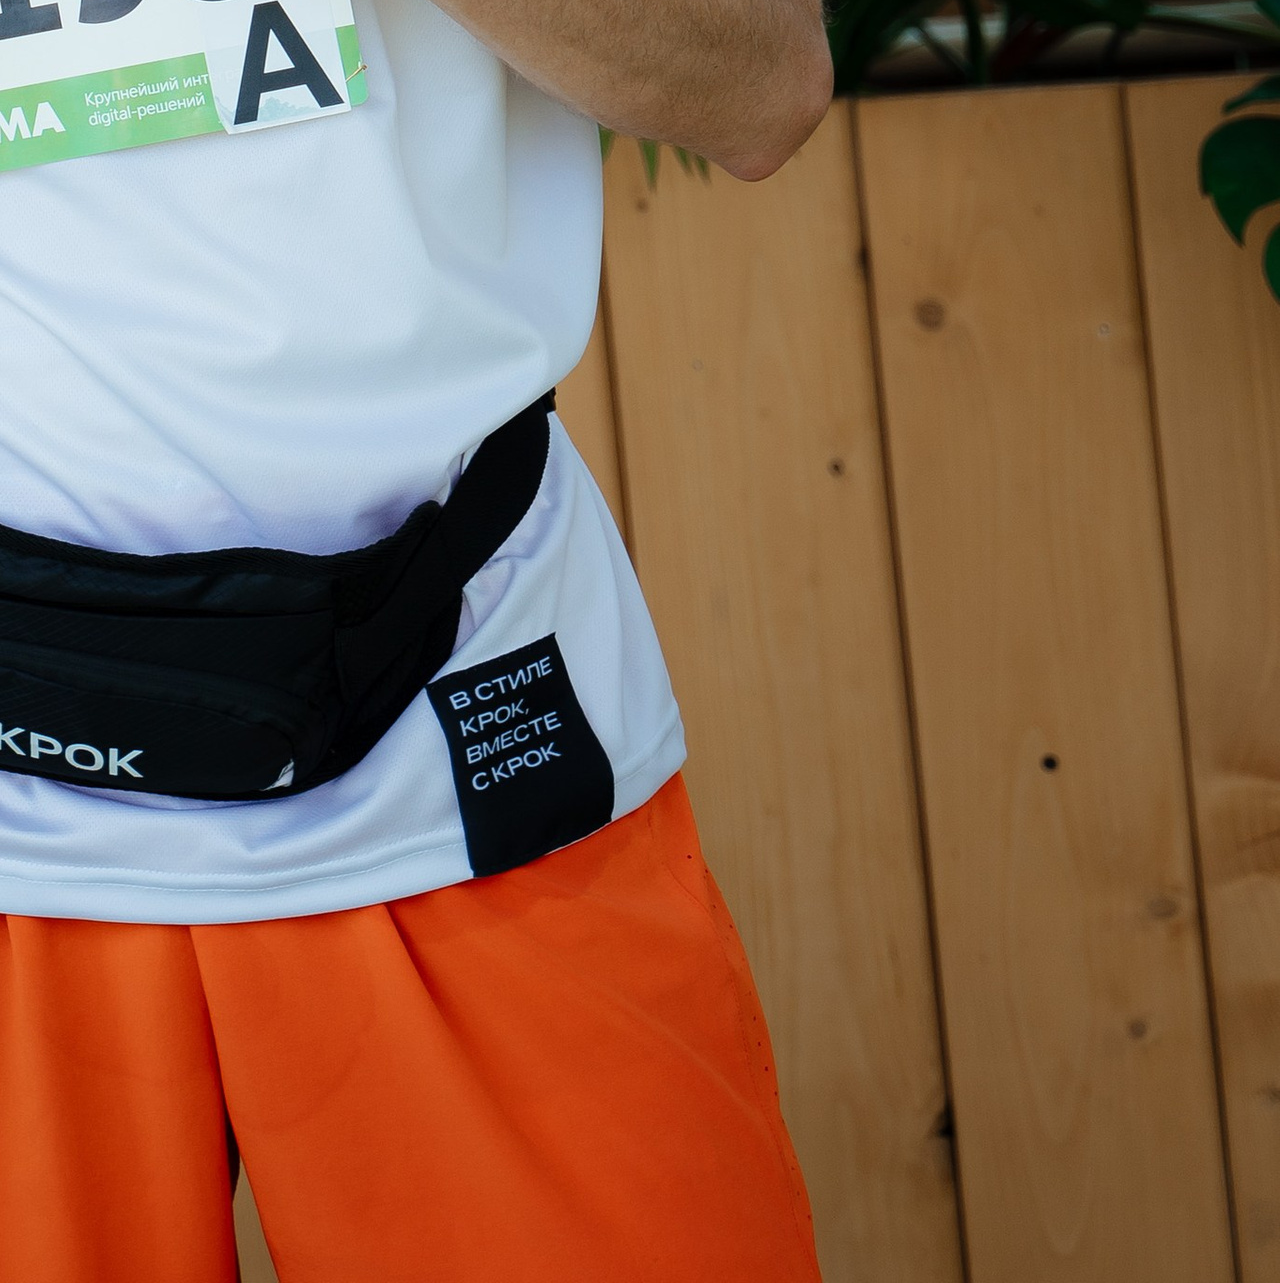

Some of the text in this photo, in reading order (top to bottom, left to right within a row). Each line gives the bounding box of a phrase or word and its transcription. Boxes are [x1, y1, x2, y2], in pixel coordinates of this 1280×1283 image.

[232, 0, 345, 127] A
[84, 76, 179, 108] Крупнейший
[88, 91, 206, 127] digital-решений
[448, 655, 553, 711] В СТИЛЕ
[459, 698, 530, 737] КРОК,
[465, 710, 563, 765] ВМЕСТЕ
[471, 741, 562, 791] С КРОК
